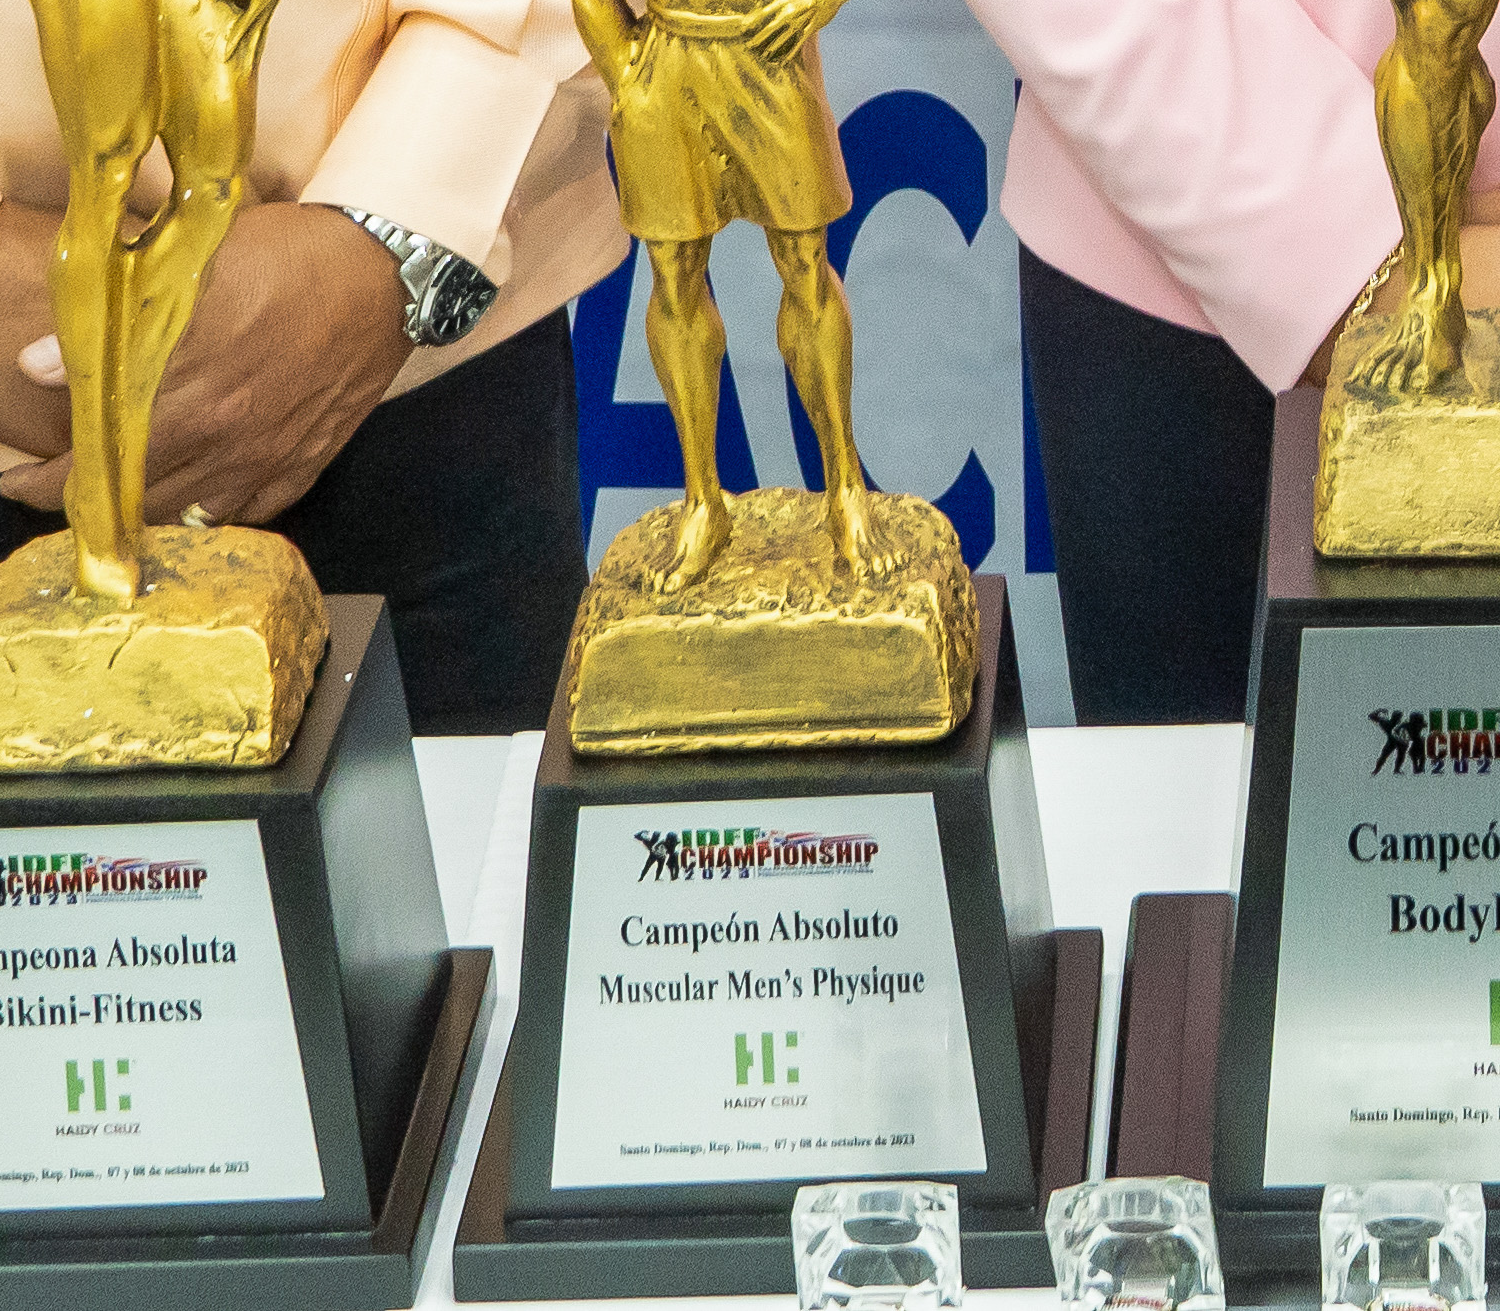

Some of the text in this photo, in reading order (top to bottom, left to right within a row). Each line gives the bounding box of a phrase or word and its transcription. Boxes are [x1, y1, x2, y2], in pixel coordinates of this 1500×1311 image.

[680, 842, 879, 869] CHAMPIONSHIP
[6, 869, 208, 894] CHAMPIONSHIP
[620, 909, 899, 953] Campeón Absoluto
[107, 936, 237, 968] Absoluta
[599, 974, 718, 1005] Muscular
[813, 966, 925, 1005] Physique
[723, 1097, 766, 1110] HAIDY
[1350, 1107, 1388, 1122] Santo
[1393, 1106, 1457, 1126] Domingo,
[1462, 1105, 1492, 1125] Rep.
[55, 1123, 99, 1136] HAIDY
[774, 1138, 788, 1150] 07
[800, 1137, 813, 1149] 08
[107, 1166, 120, 1178] 07
[132, 1165, 145, 1177] 08
